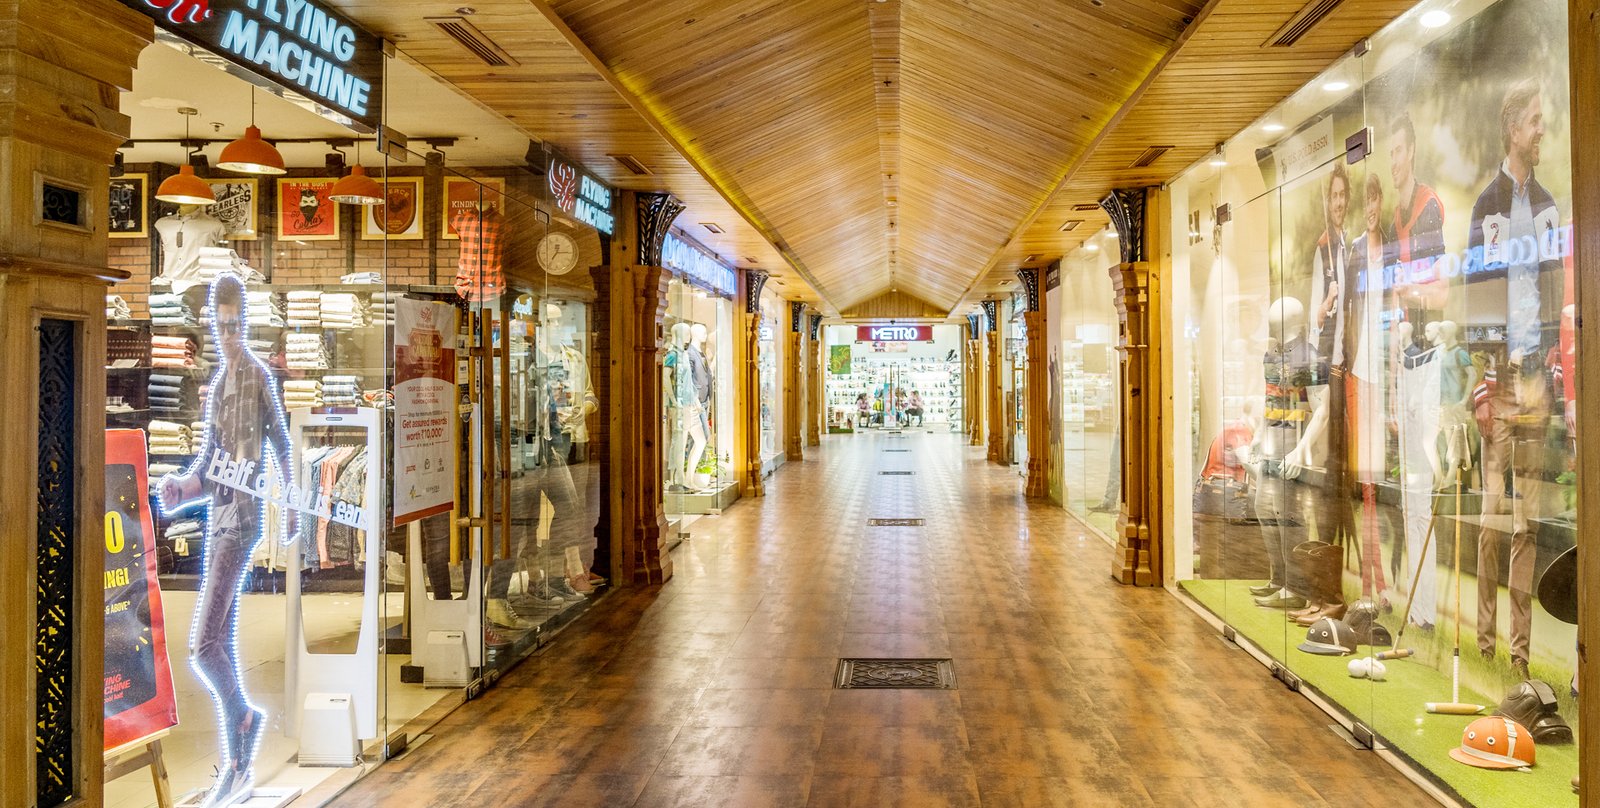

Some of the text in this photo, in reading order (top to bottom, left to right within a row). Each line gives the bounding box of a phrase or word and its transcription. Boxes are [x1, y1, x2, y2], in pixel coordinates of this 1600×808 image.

[220, 10, 371, 117] MACHINE
[205, 190, 251, 215] FEARLESS
[581, 175, 610, 209] FLYING
[451, 200, 497, 208] KINDNS
[575, 198, 613, 235] MACHINE
[871, 327, 918, 340] METRO
[402, 415, 448, 429] Get assured rewards
[406, 430, 421, 441] worth
[206, 447, 255, 488] Half
[105, 511, 124, 554] 0
[104, 567, 130, 590] ING!
[104, 673, 122, 685] ING
[104, 679, 131, 696] CHINE
